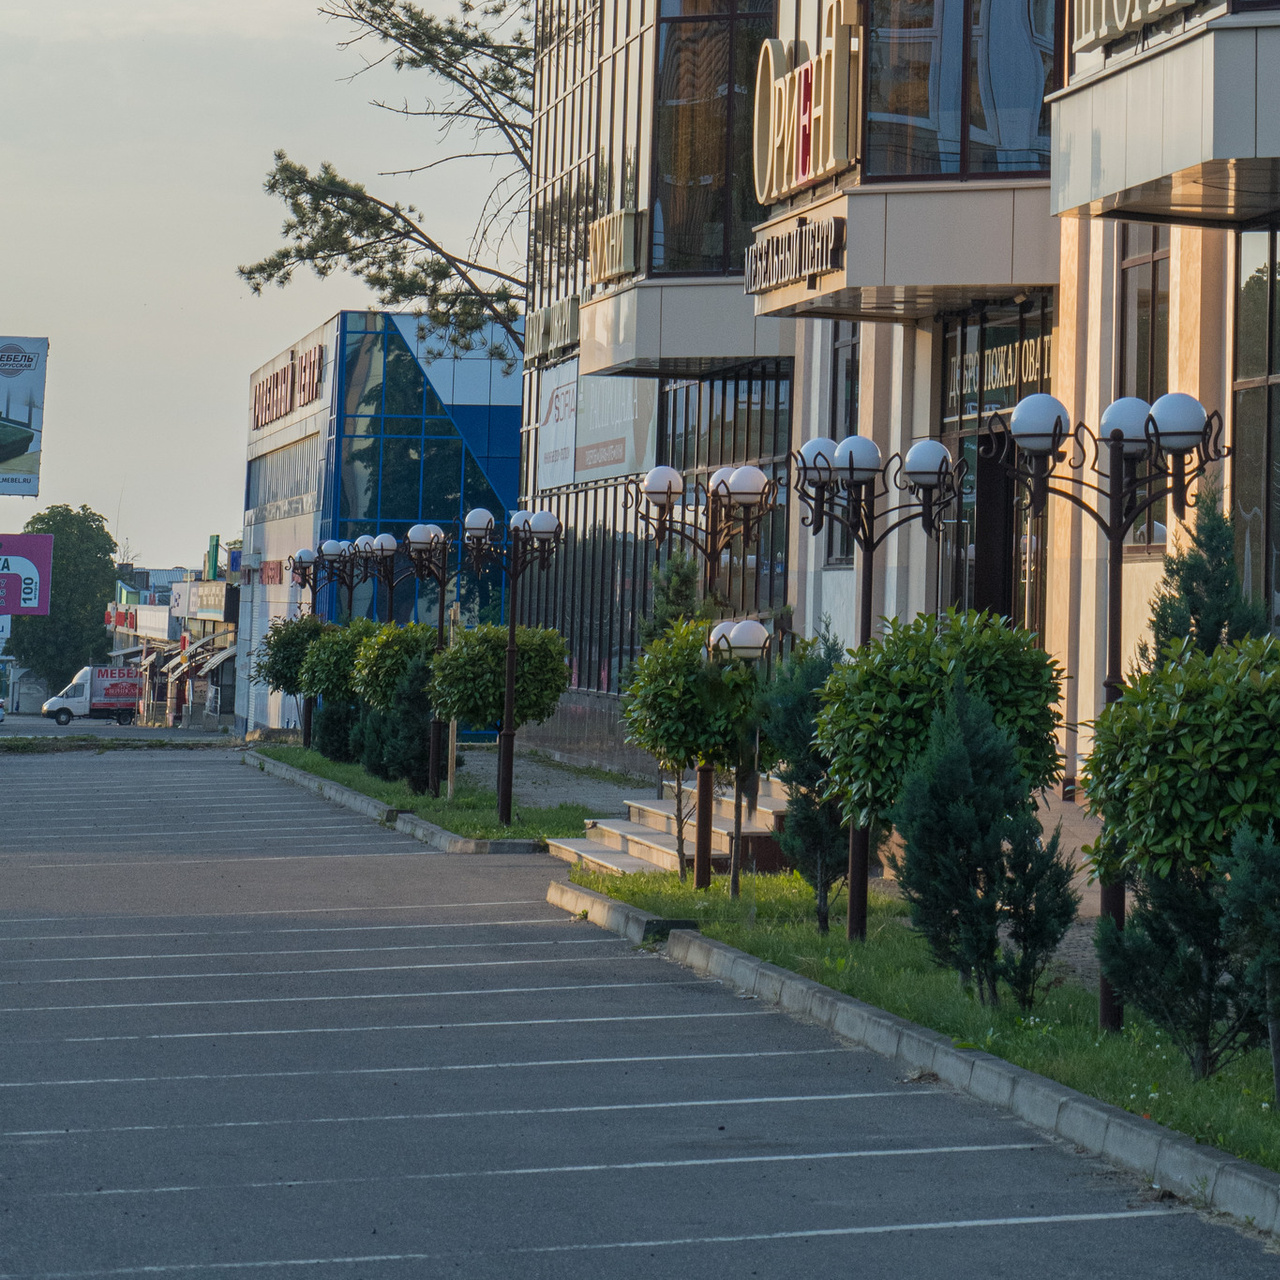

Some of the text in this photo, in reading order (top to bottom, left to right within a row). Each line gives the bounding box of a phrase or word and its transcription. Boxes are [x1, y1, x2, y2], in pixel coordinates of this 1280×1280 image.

[590, 208, 635, 285] КУХНИ
[744, 217, 846, 294] МЕБЕЛЬНЫЙ ЦЕНТР
[949, 351, 979, 408] ДОБРО
[22, 577, 34, 604] 100
[97, 669, 143, 678] МЕБЕЛ
